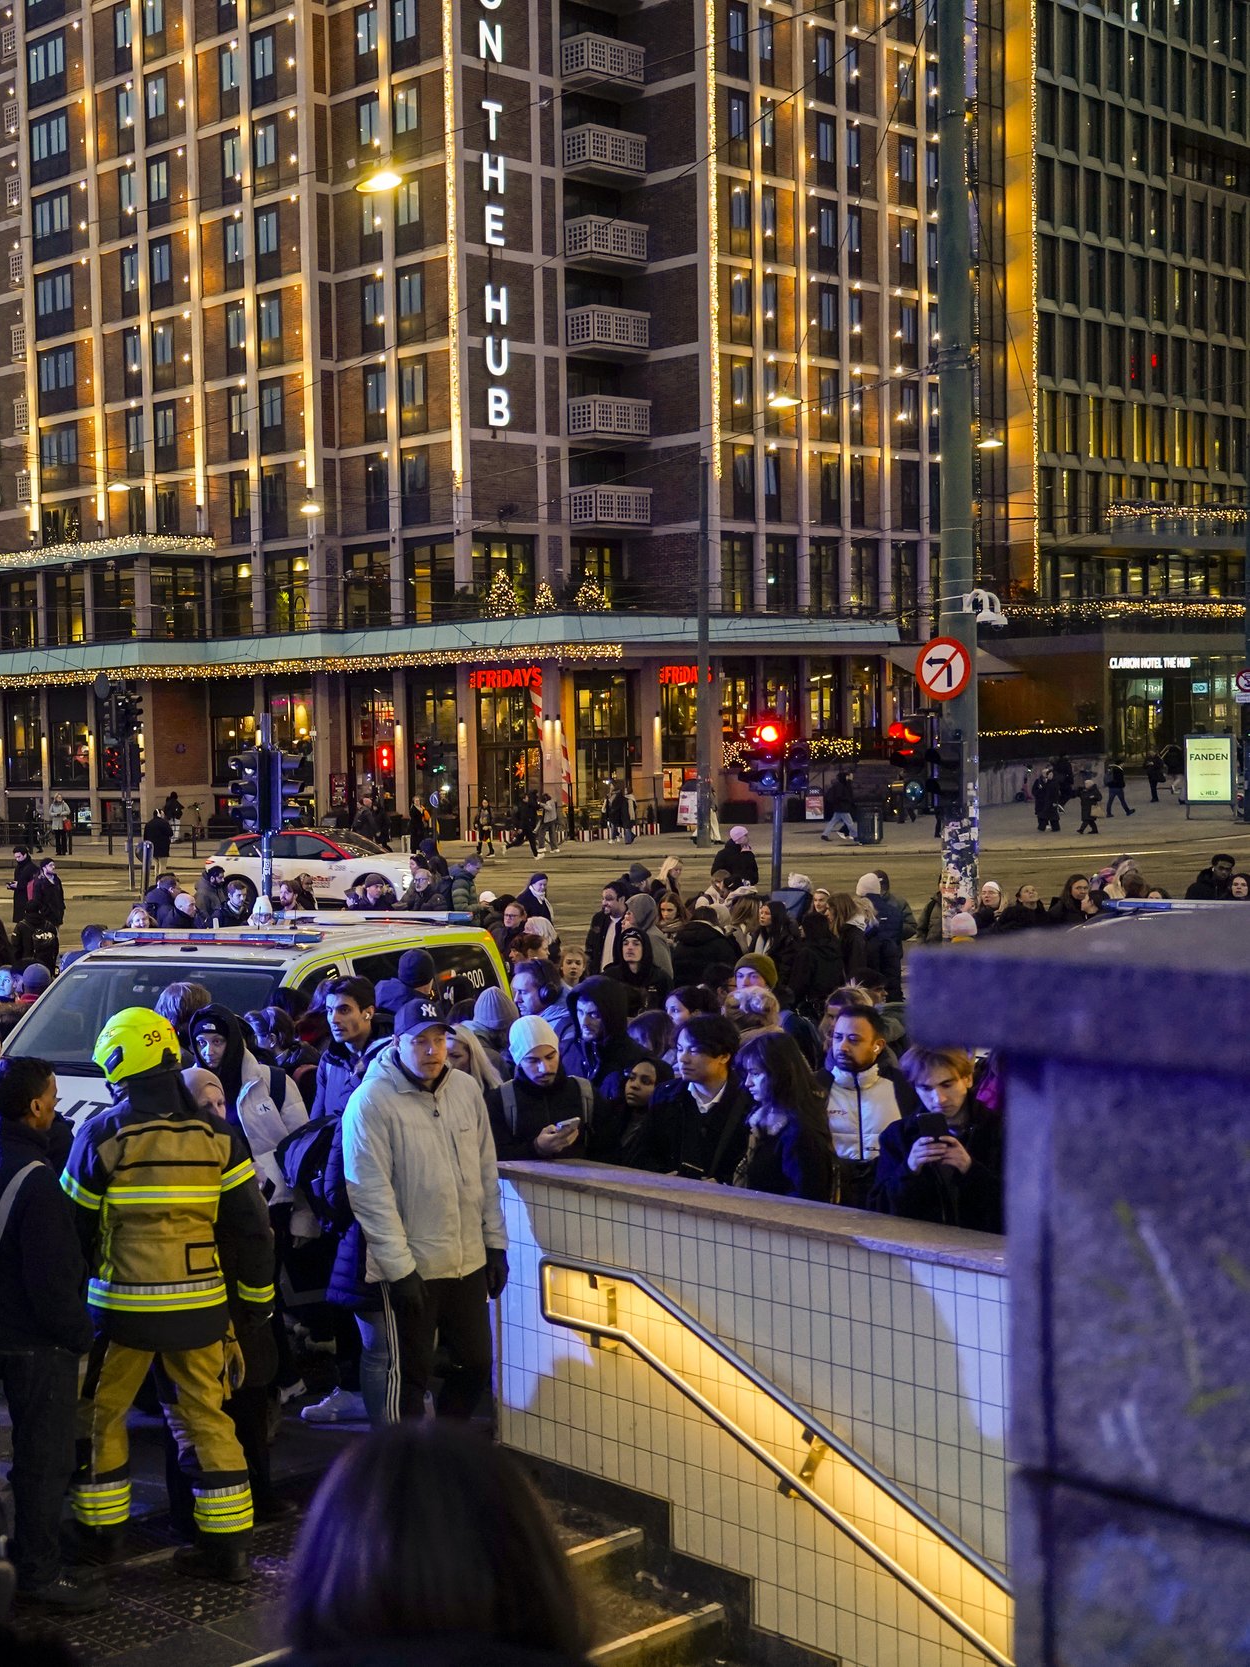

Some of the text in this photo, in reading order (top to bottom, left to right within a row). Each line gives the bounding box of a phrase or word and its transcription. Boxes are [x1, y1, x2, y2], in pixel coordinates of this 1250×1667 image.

[479, 0, 510, 427] N THE HUB
[1109, 657, 1191, 669] CLARION HOTEL THE HUB
[1190, 753, 1229, 761] FANDEN
[143, 1030, 162, 1047] 39
